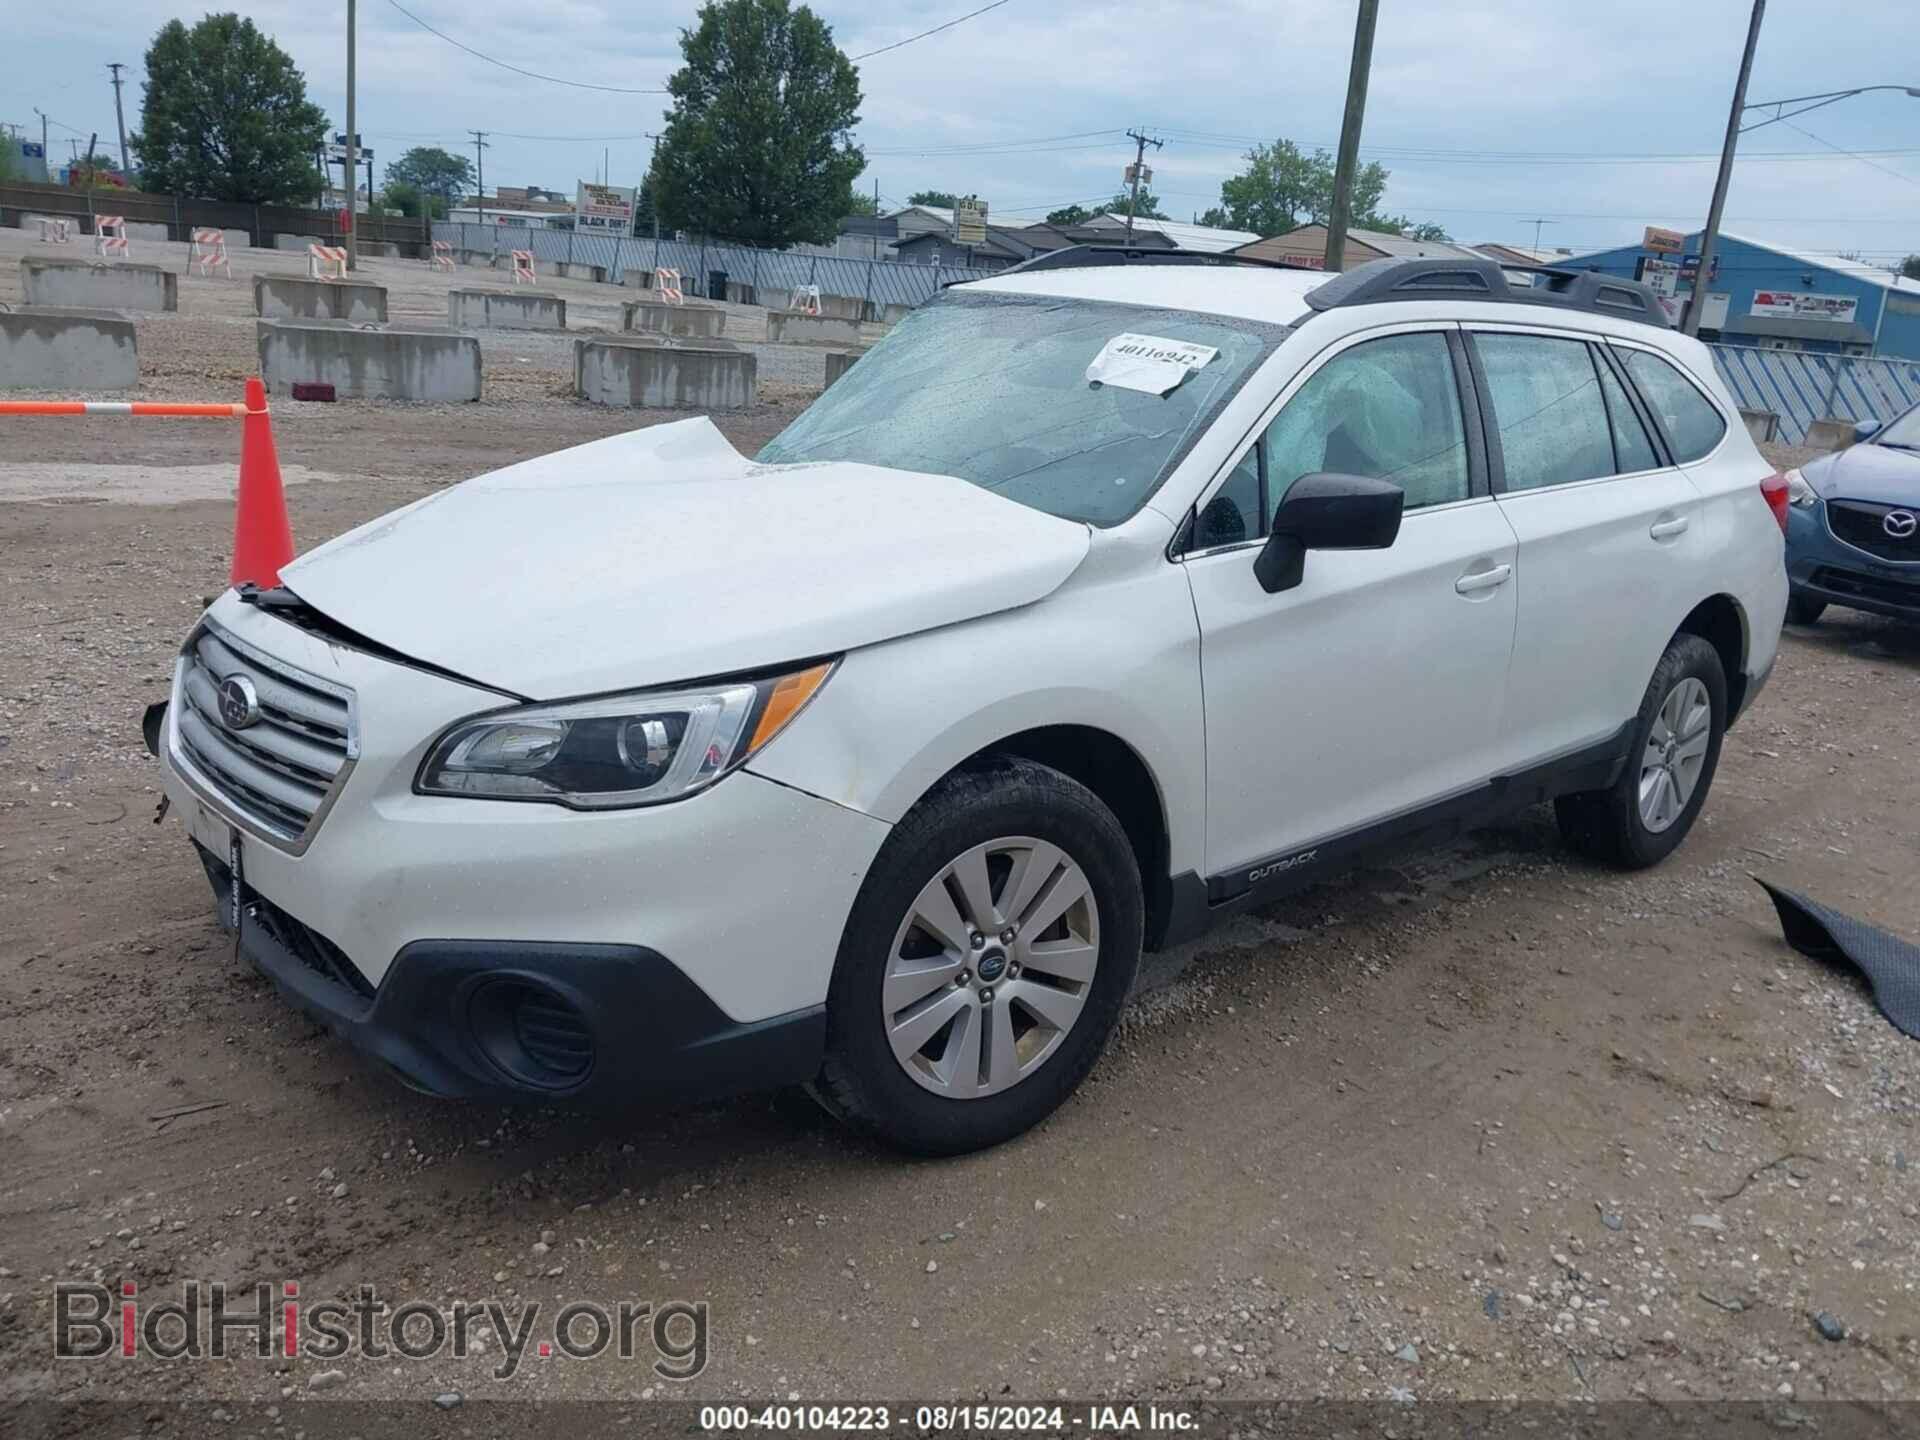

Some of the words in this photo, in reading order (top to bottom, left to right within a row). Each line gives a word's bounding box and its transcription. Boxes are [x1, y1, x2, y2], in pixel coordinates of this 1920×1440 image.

[579, 215, 605, 226] BLACK
[608, 218, 627, 228] DIRT
[1287, 255, 1308, 265] BODY
[231, 846, 239, 878] PARK
[1248, 849, 1318, 882] OUTBACK
